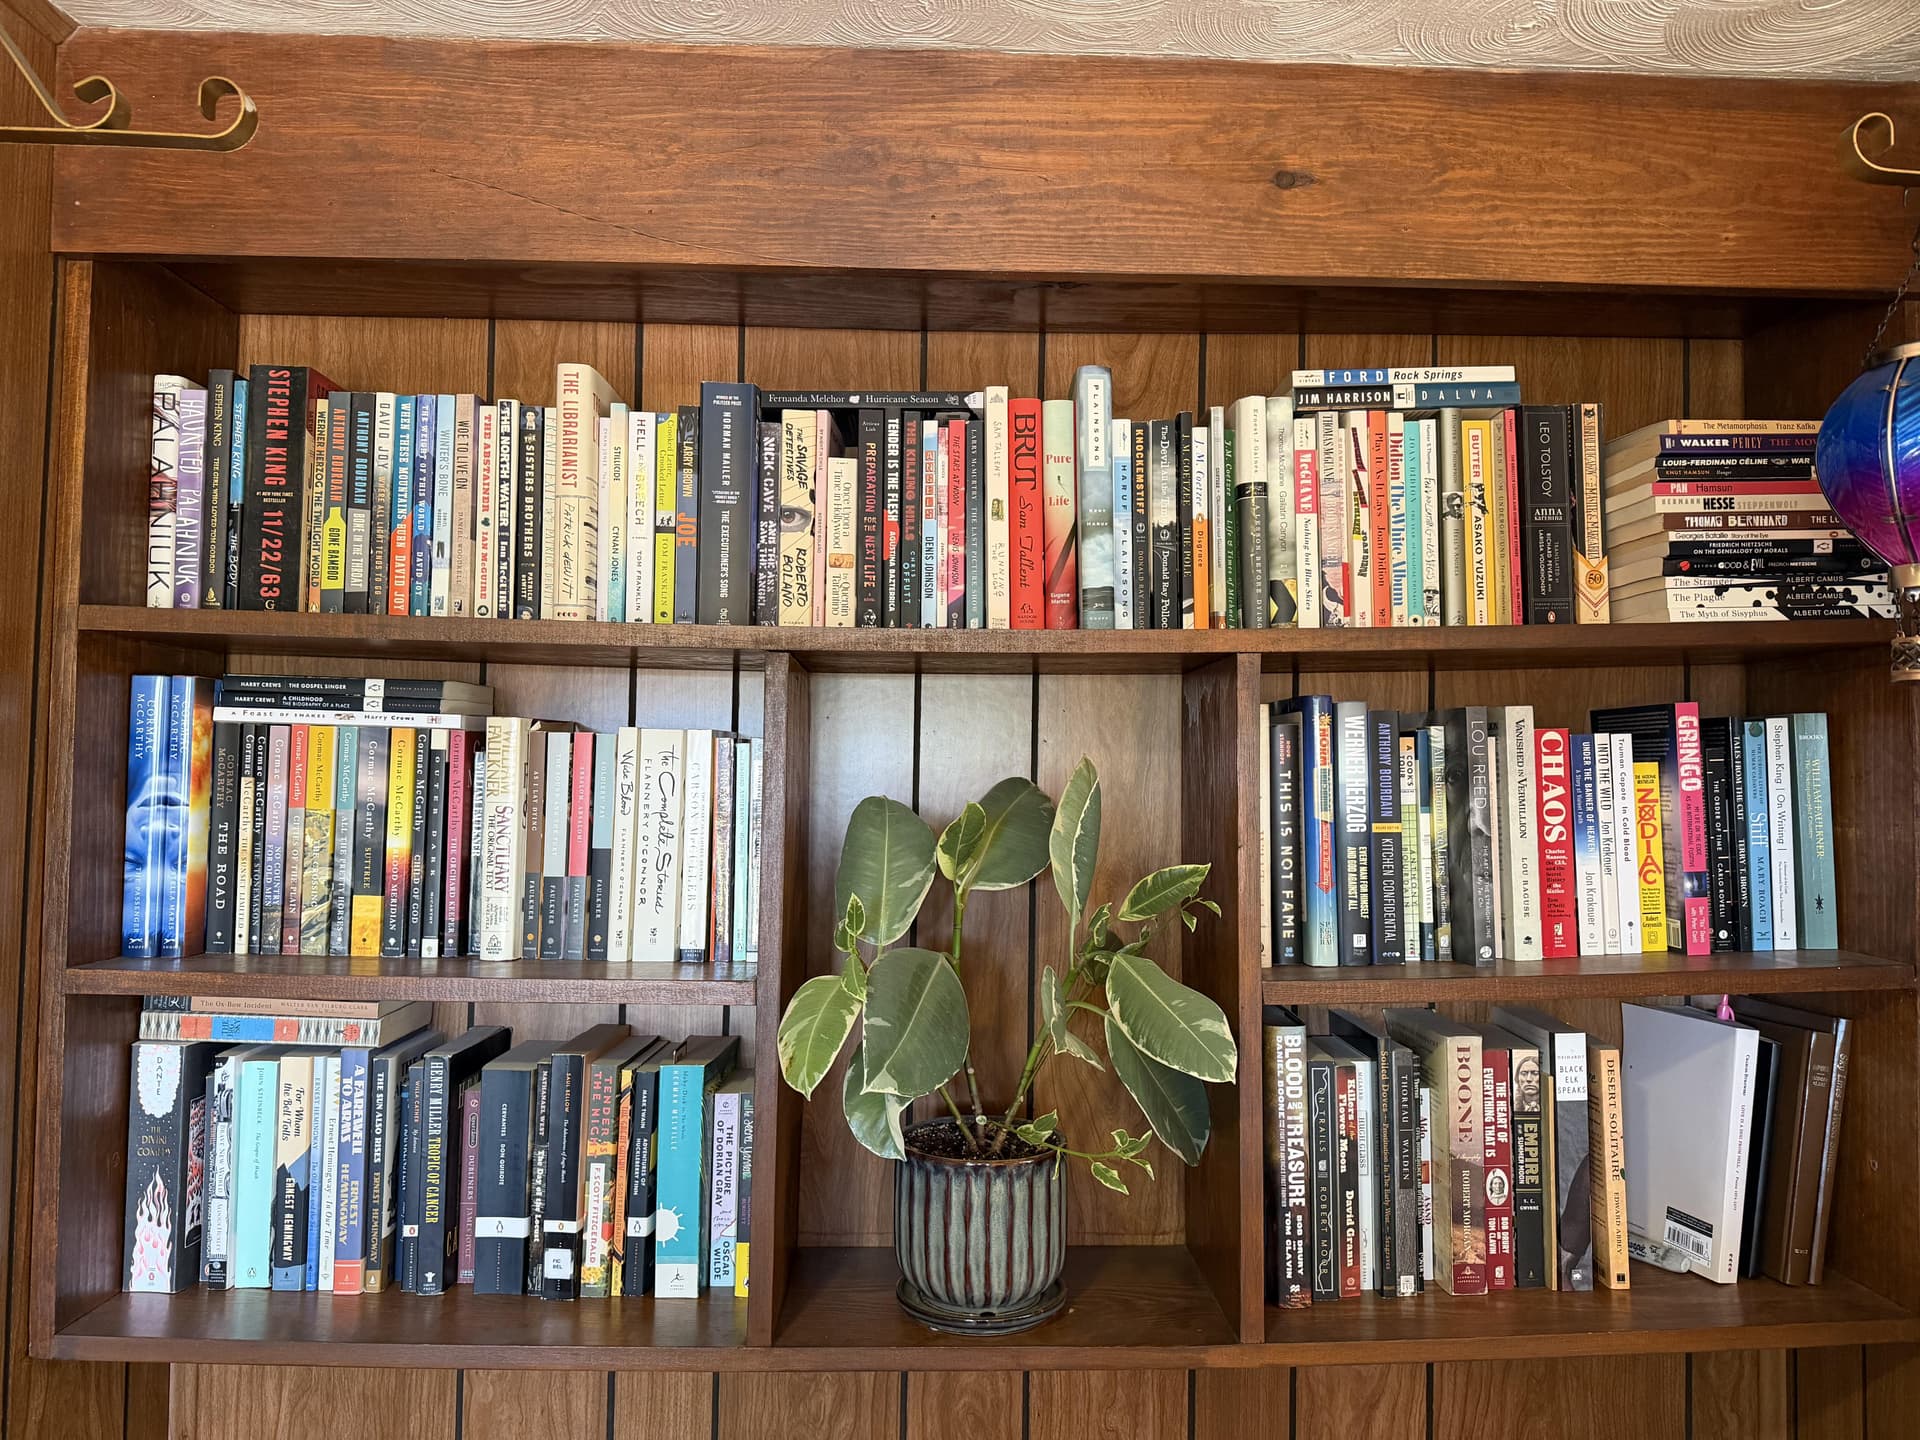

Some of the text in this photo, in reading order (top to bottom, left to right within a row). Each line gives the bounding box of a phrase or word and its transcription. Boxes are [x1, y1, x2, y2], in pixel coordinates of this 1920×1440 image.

[769, 394, 938, 404] Fernanda Melchor Hurricane Season
[1299, 392, 1391, 404] JIM HARRISON
[1329, 370, 1463, 382] FORD Rock Springs
[1422, 390, 1493, 400] DALVA
[213, 384, 224, 447] STEPHEN KING
[232, 403, 242, 479] STEPHEN KING
[264, 370, 290, 486] STEPHEN KING
[378, 403, 390, 469] DAVID JOY
[562, 372, 579, 488] THE LIBRARIANIST
[722, 412, 731, 486] NORMAN MAILER
[1014, 413, 1036, 490] BRUT
[330, 408, 345, 502] ANTHONY BOURDAIN
[354, 411, 369, 504] ANTHONY BOURDAIN
[683, 441, 694, 497] LARRY BROWN
[786, 423, 794, 481] DETECTIVES
[795, 446, 808, 490] SAVAGE
[888, 419, 899, 521] TENDER IS THE FLESH
[1046, 454, 1072, 506] Pure Life
[1472, 435, 1480, 478] BUTTER
[1540, 421, 1552, 497] LEO TOLSTOY
[1670, 483, 1733, 493] PAN Hamsun
[524, 445, 534, 557] SISTERS BROTHERS
[676, 512, 696, 547] JOE
[260, 510, 284, 598] 11/22/63
[327, 528, 340, 581] GONE BAMBOO
[394, 556, 406, 610] DAVID JOY
[782, 555, 795, 607] BOLAÑO
[796, 548, 808, 607] ROBERTO
[925, 537, 934, 599] DENIS JOHNSON
[1476, 560, 1484, 600] YUZUKI
[1698, 610, 1721, 619] Myth
[1731, 610, 1768, 619] Sisyphus
[1345, 716, 1366, 832] WERNER HERZOG
[1378, 723, 1393, 816] ANTHONY BOURDAIN
[1472, 721, 1486, 808] LOU REED
[1541, 732, 1566, 842] CHAOS
[1678, 715, 1702, 791] GRINGO
[638, 759, 652, 906] FLANNERY O'CONNOR
[1598, 744, 1613, 876] INTO THE WILD Jon Krakauer
[216, 823, 228, 909] THE ROAD
[1280, 770, 1294, 938] THIS IS NOT FAME
[1382, 839, 1396, 943] KITCHEN CONFIDENTIAL
[1586, 872, 1598, 925] Jon Krakauer
[1285, 1035, 1302, 1099] BLOOD
[1347, 1079, 1356, 1120] Killers
[1457, 1046, 1472, 1142] BOONE
[341, 1077, 353, 1143] TO ARMS
[352, 1065, 365, 1155] A FAREWELL
[426, 1062, 443, 1224] HENRY MILLER TROPIC OF CANCER
[717, 1121, 724, 1135] OF
[1484, 1068, 1495, 1157] EVERYTHING THAT IS
[1496, 1082, 1508, 1143] THE HEART OF
[1607, 1059, 1620, 1180] DESERT SOLITAIRE
[716, 1138, 724, 1176] DORIAN
[724, 1125, 734, 1196] THE PICTURE
[1286, 1112, 1306, 1207] TREASURE
[1524, 1124, 1538, 1185] EMPIRE
[282, 1178, 295, 1262] ERNEST HEMINGWAY
[339, 1164, 349, 1245] HEMINGWAY
[350, 1181, 359, 1226] ERNEST
[1346, 1190, 1355, 1267] David Grann
